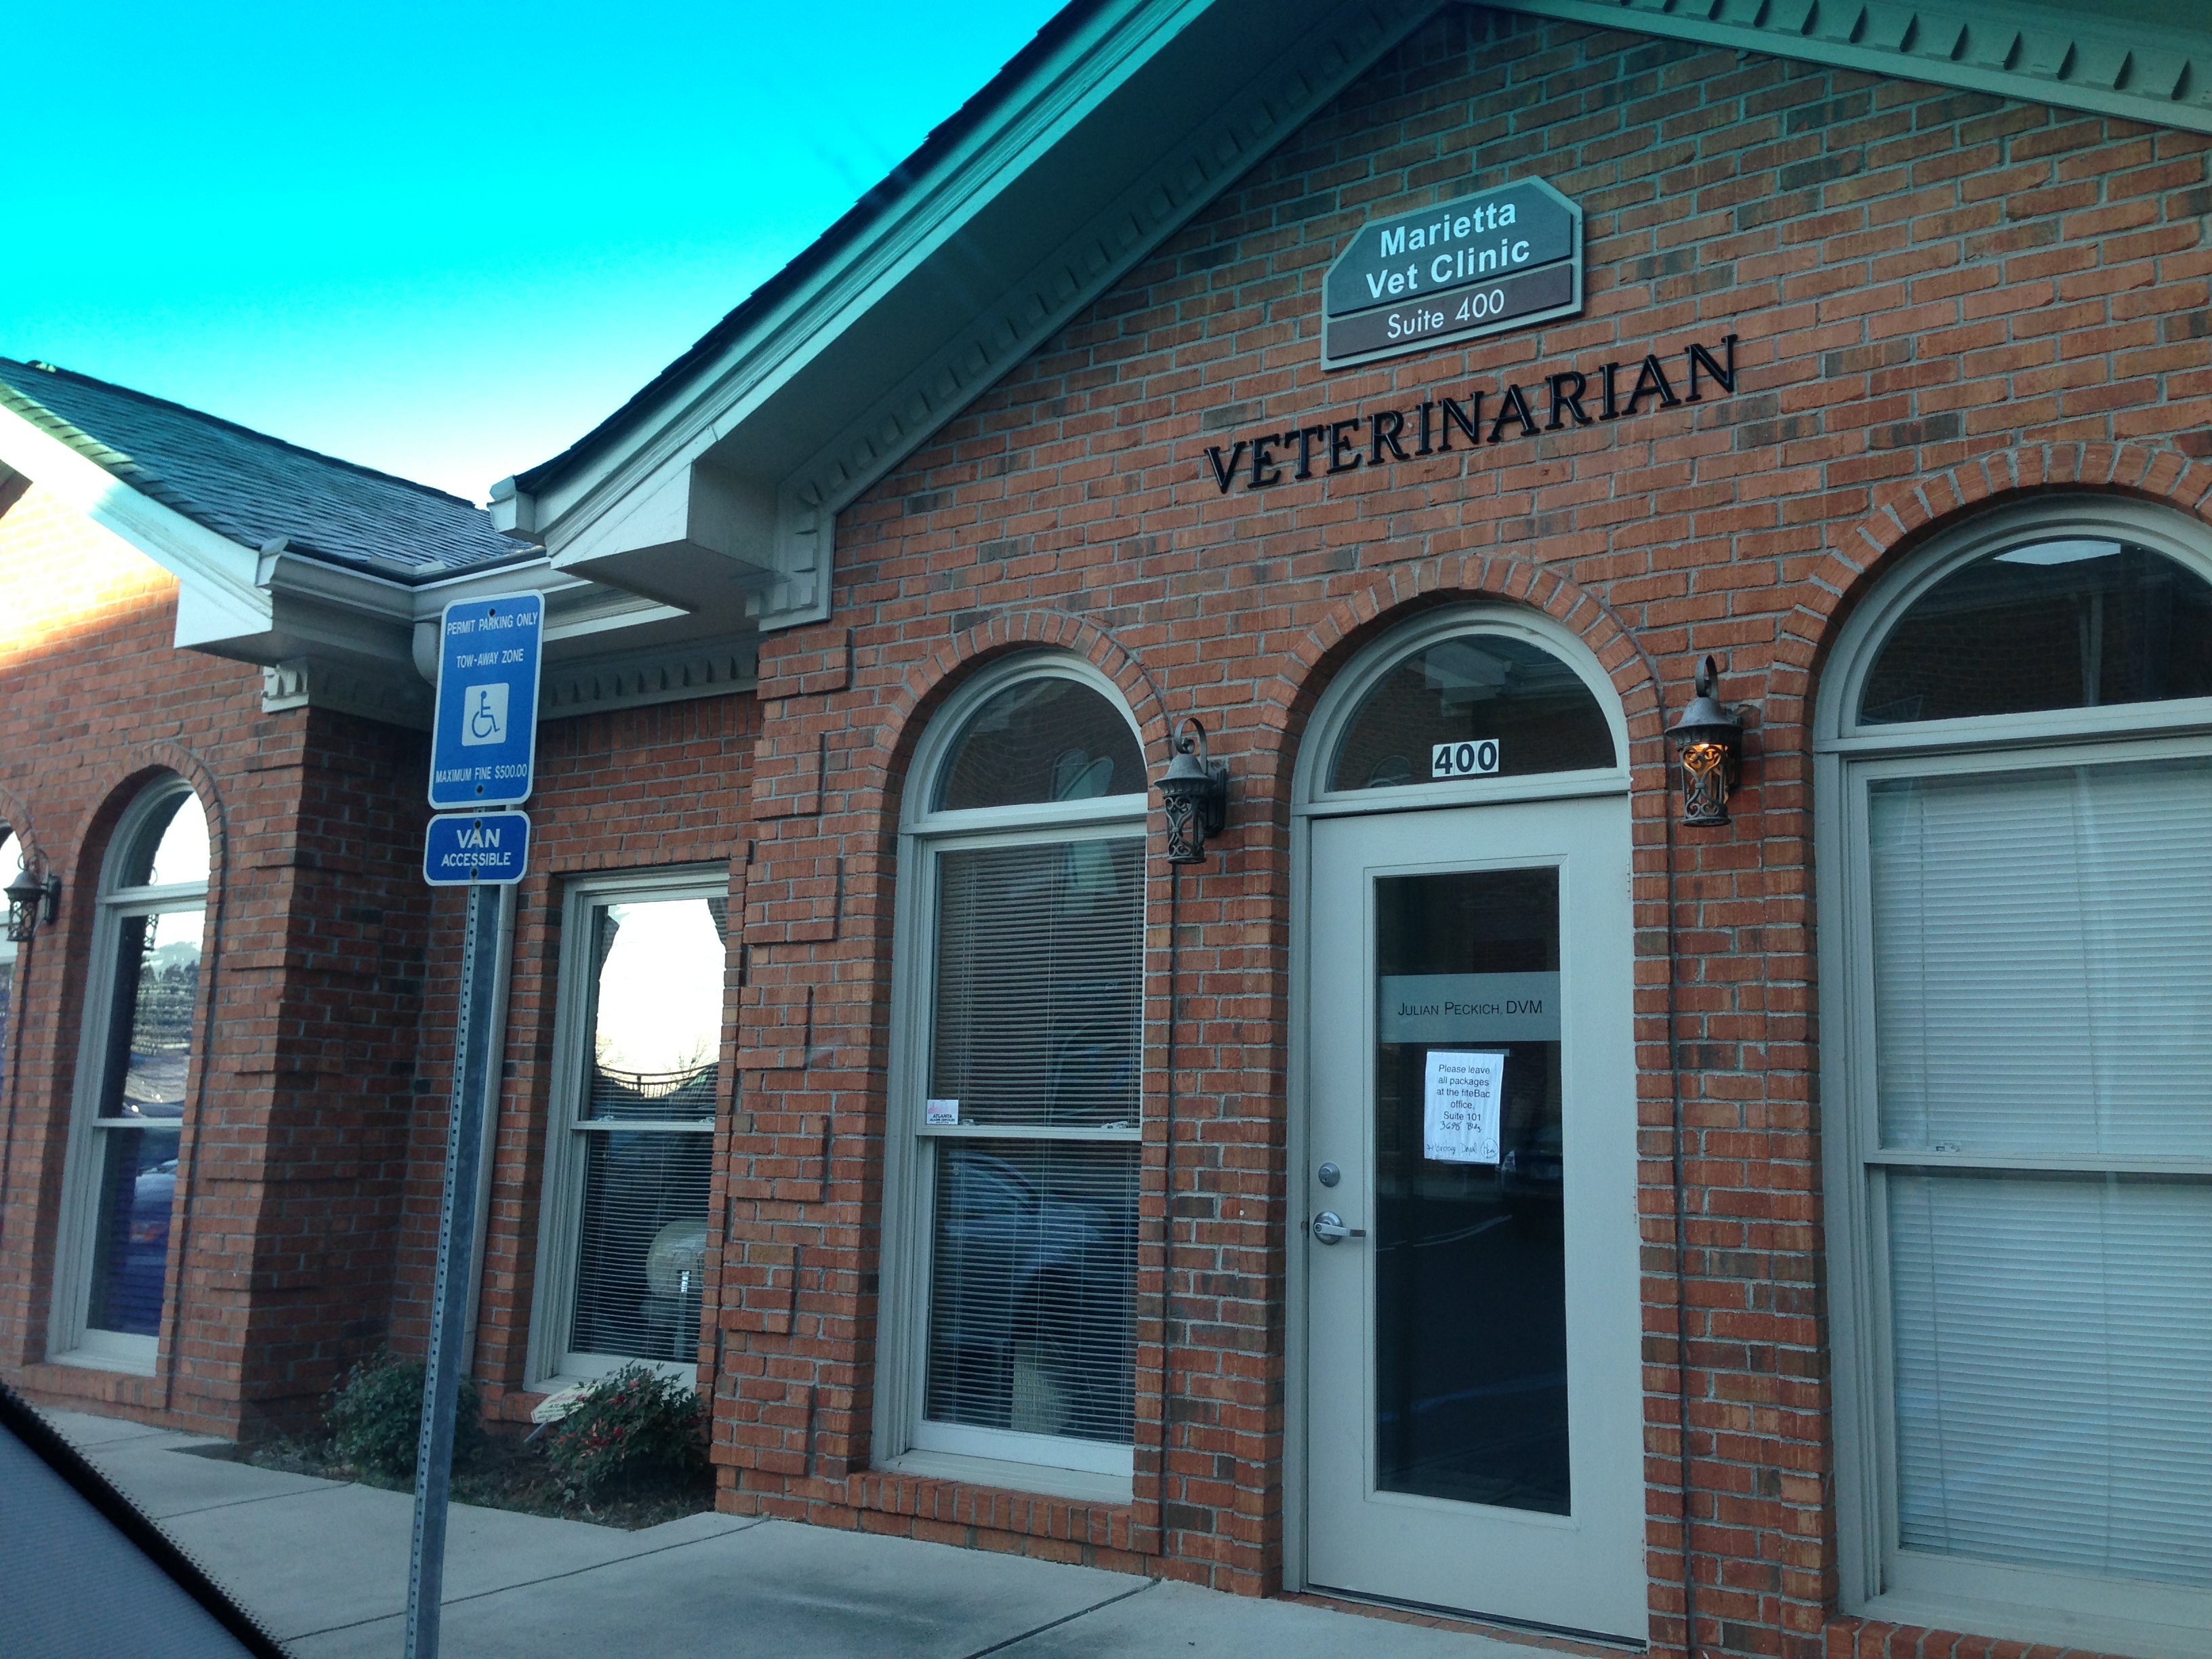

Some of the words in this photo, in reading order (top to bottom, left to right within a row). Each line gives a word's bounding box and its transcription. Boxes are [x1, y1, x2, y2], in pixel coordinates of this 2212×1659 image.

[1380, 202, 1517, 258] Marietta
[1366, 263, 1418, 298] Vet
[1431, 238, 1530, 283] Clinic
[1387, 309, 1444, 338] Suite
[1455, 289, 1504, 321] 400
[1204, 333, 1738, 494] VETERINARIAN
[447, 619, 476, 636] PERMIT
[478, 614, 514, 632] PARKING
[516, 612, 539, 627] ONLY
[456, 651, 499, 668] TOW-AWAY
[501, 648, 525, 663] ZONE
[1434, 741, 1497, 775] 400
[435, 768, 472, 783] MAXIMUM
[474, 766, 492, 781] FINE
[494, 763, 527, 779] $500.00
[456, 828, 501, 848] VAN
[441, 852, 512, 867] ACCESSIBLE
[1398, 1002, 1439, 1016] JULIAN
[1506, 1000, 1542, 1014] DVM
[1438, 1064, 1467, 1073] Please
[1468, 1065, 1490, 1074] leave
[1438, 1076, 1448, 1084] all
[1450, 1077, 1490, 1088] packages
[1436, 1088, 1444, 1096] at
[1446, 1088, 1459, 1097] the
[1461, 1088, 1491, 1098] fiteBac
[1450, 1100, 1475, 1111] office,
[1443, 1111, 1464, 1120] Suite
[1467, 1113, 1481, 1121] 101
